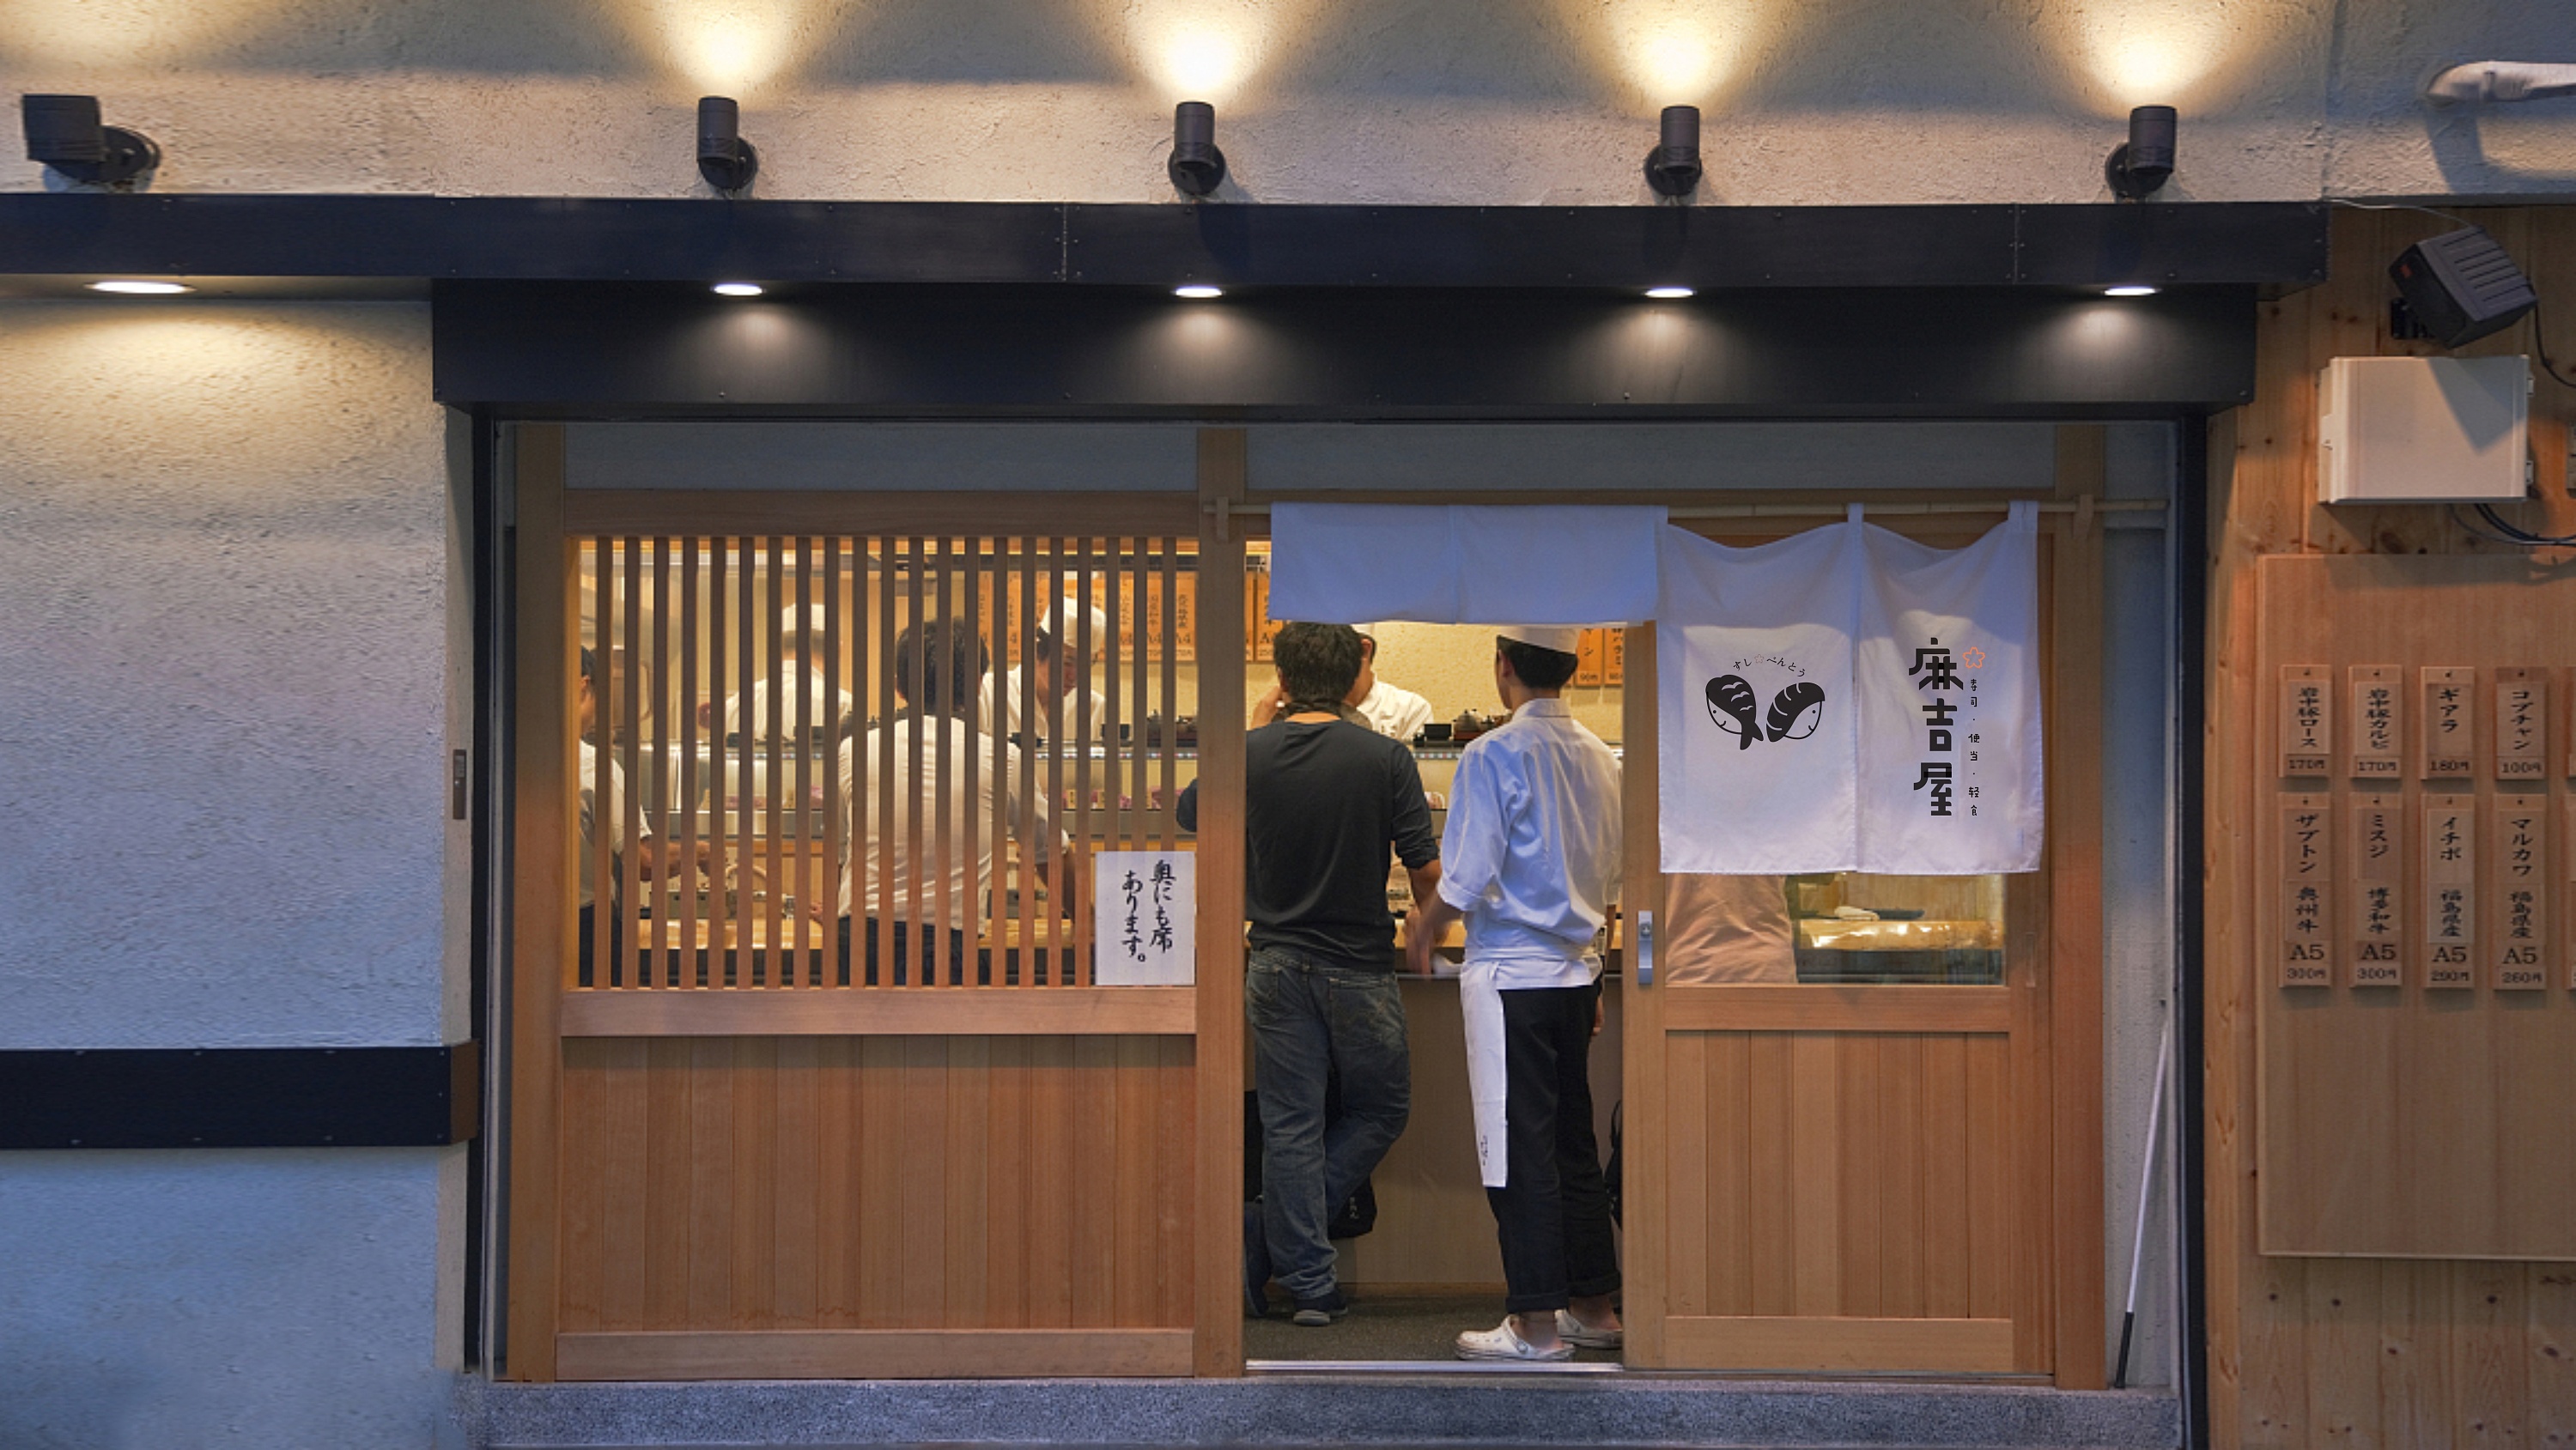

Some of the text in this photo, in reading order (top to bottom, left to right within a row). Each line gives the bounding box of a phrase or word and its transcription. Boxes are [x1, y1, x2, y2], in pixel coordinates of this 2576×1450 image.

[1734, 658, 1752, 671] すし
[2439, 688, 2460, 734] ギアラ
[2511, 690, 2534, 751] コブチャン
[1909, 637, 1964, 816] 麻吉屋
[2359, 761, 2397, 772] 170円
[2501, 761, 2542, 774] 100円
[2295, 814, 2320, 874] ザブトン
[2369, 815, 2389, 858] ミスジ
[2440, 816, 2462, 861] イチボ
[2511, 818, 2534, 877] マルカワ
[1122, 870, 1146, 962] あります。
[2289, 943, 2325, 961] A5
[2360, 943, 2397, 961] A5
[2432, 946, 2467, 963] A5
[2502, 947, 2539, 965] A5
[2357, 968, 2397, 980] 300円
